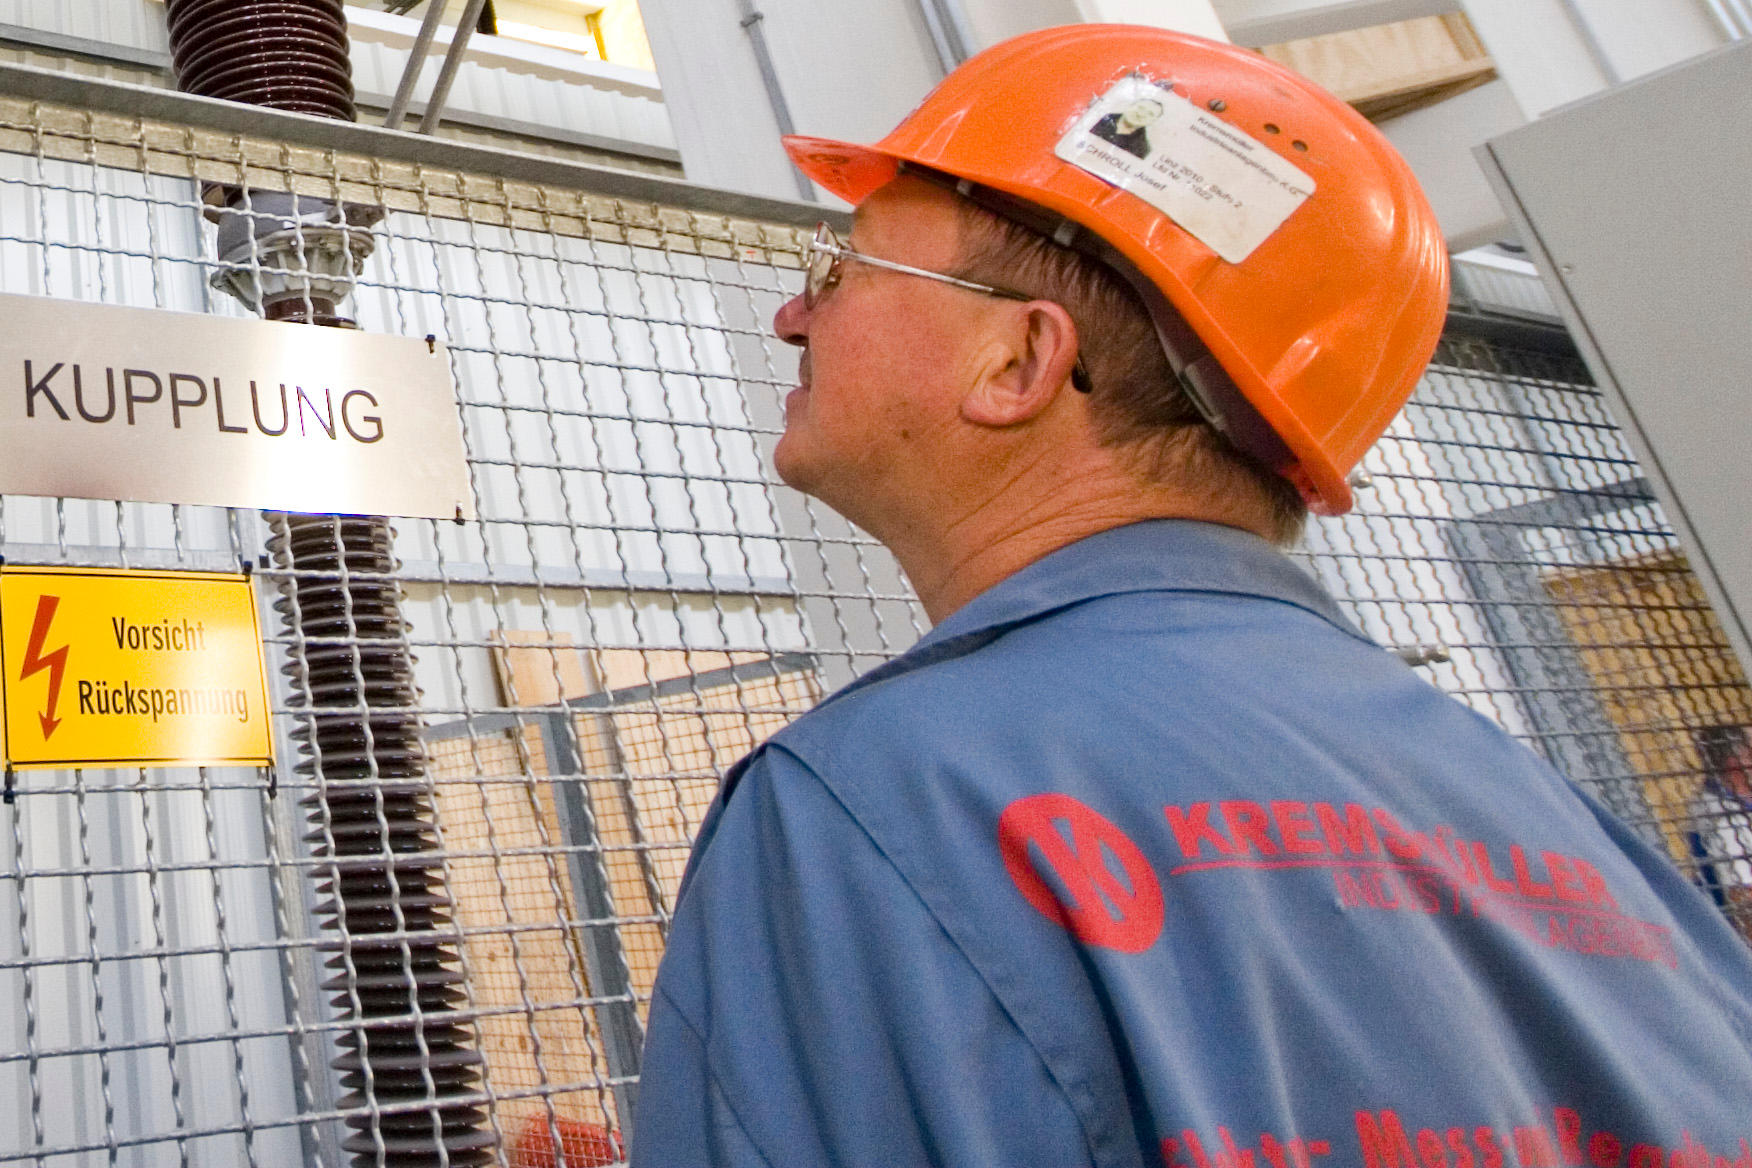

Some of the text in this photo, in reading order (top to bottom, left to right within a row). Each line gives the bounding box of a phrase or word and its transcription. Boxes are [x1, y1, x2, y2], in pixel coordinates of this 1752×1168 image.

[24, 359, 384, 444] KUPPLUNG
[112, 617, 206, 651] Vorsicht
[1163, 800, 1619, 909] KREMSÜLLER
